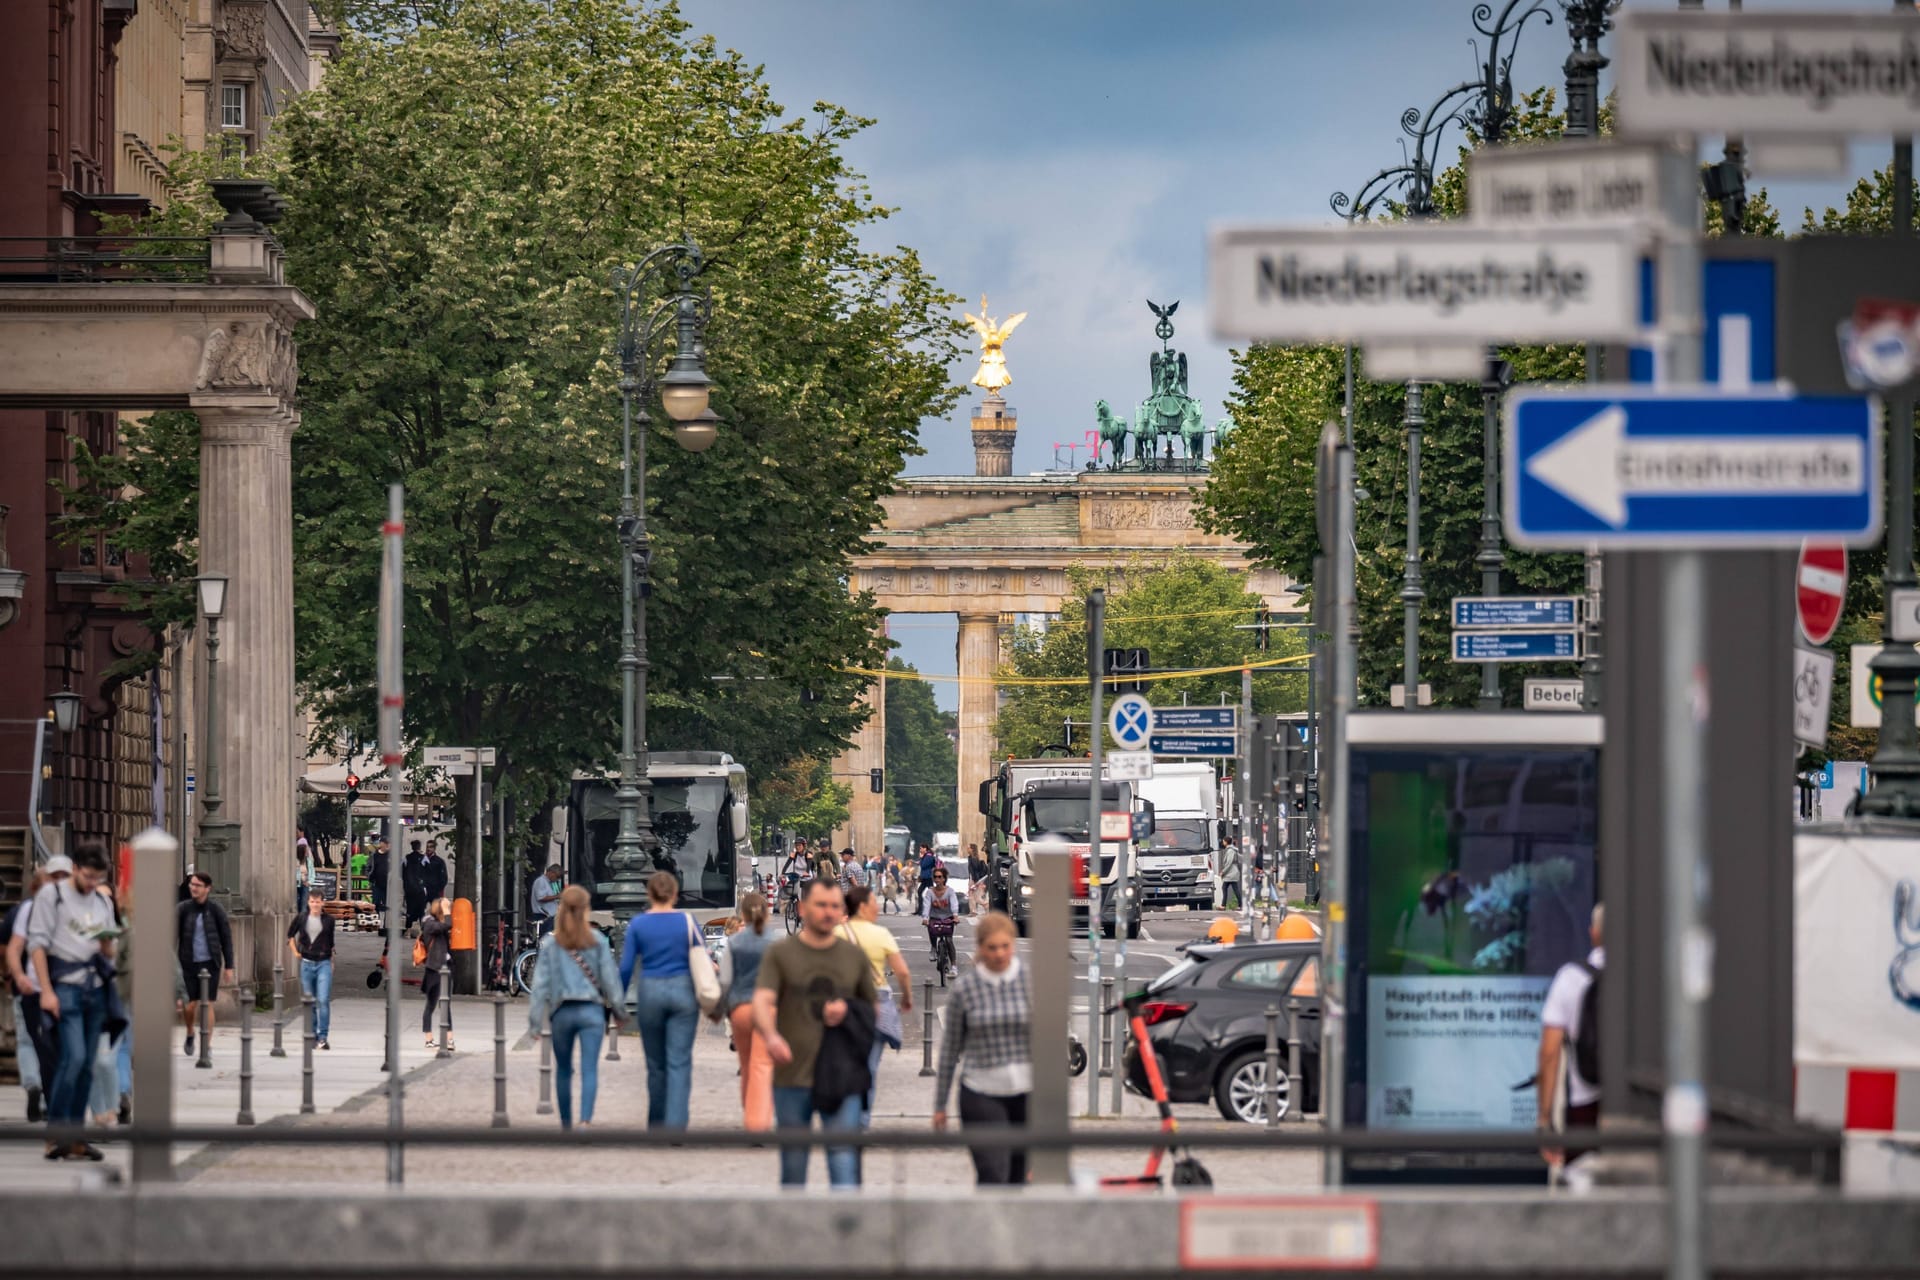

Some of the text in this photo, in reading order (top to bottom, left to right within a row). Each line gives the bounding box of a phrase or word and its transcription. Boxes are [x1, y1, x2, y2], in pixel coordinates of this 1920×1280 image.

[1255, 251, 1590, 316] Niederlagstraße
[1385, 1008, 1460, 1021] brauchen
[1463, 1008, 1496, 1022] Ihre
